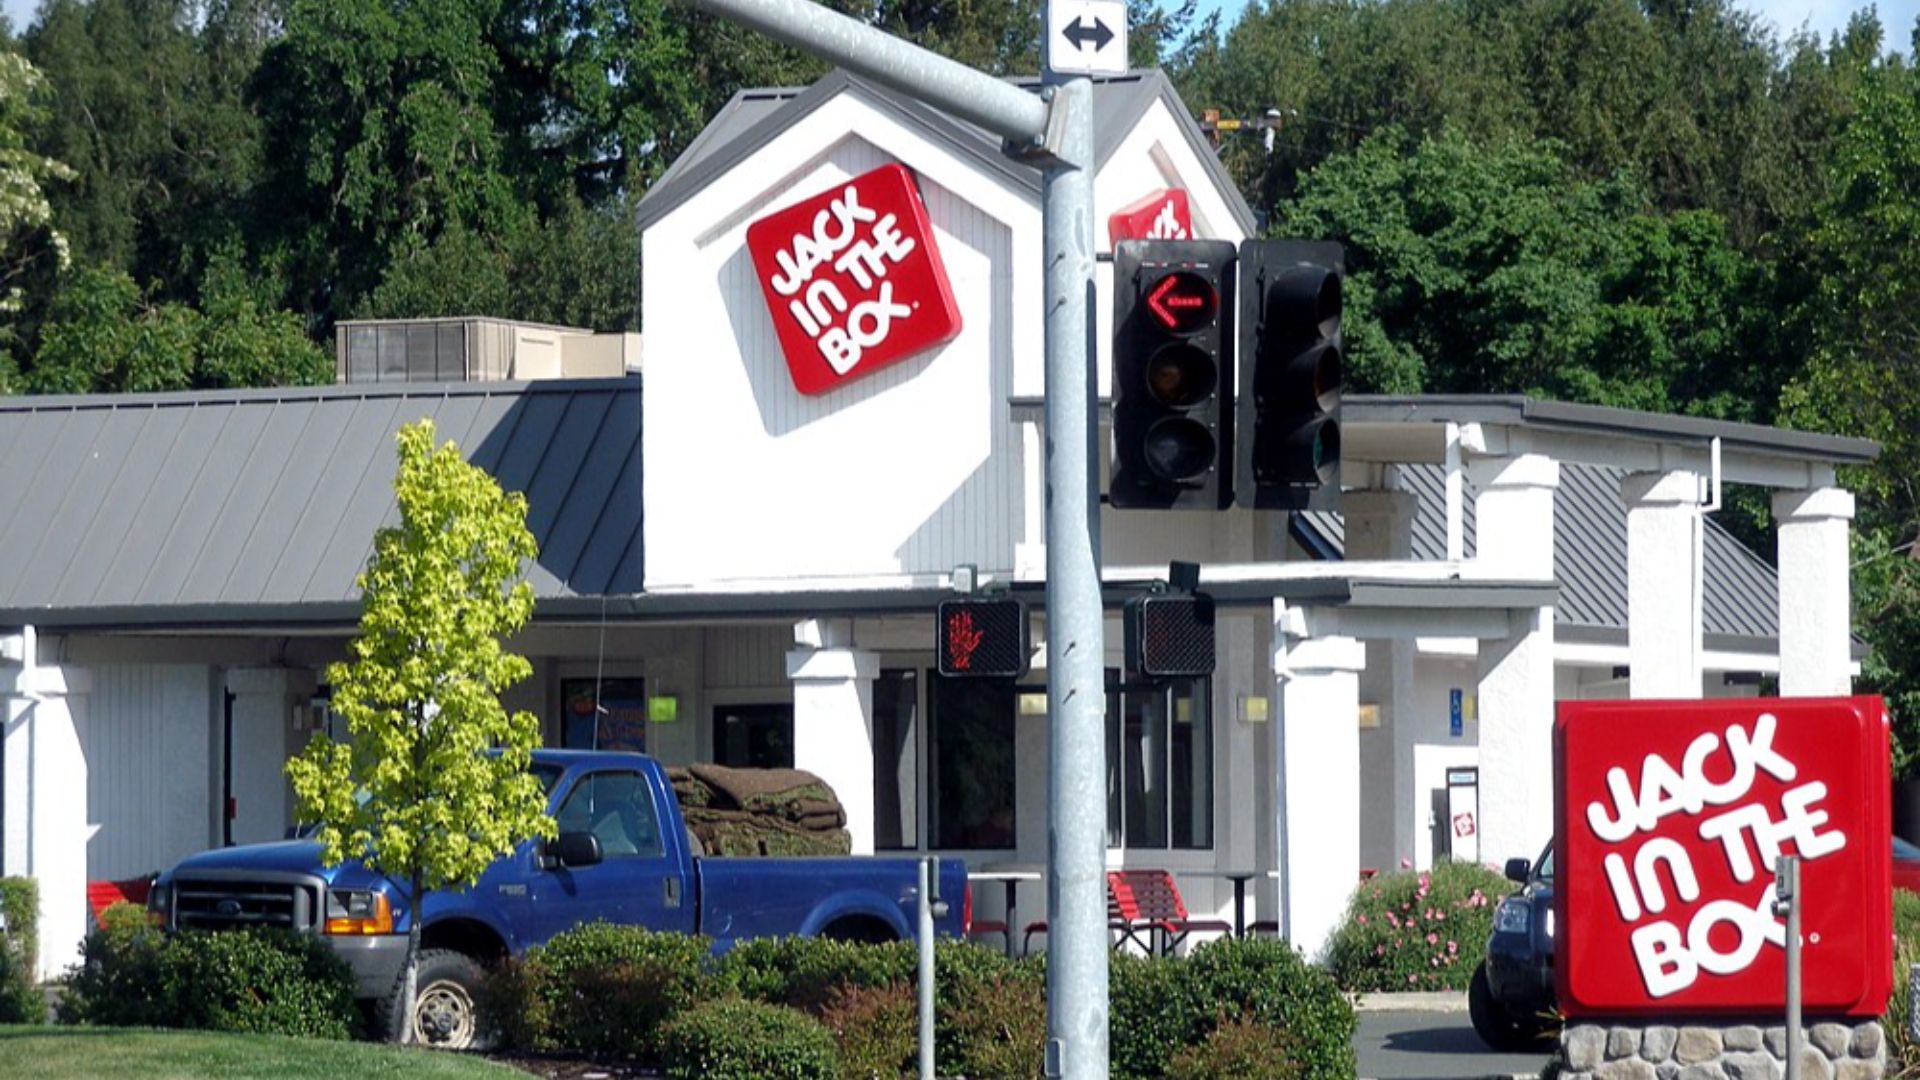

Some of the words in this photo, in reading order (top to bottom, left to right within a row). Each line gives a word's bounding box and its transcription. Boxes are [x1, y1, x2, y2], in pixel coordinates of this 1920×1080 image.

[771, 186, 877, 295] JACK
[790, 279, 848, 337] IN
[835, 213, 915, 289] THE
[817, 281, 912, 375] BOX
[1587, 713, 1797, 842] JACK
[1604, 837, 1700, 921] IN
[1699, 780, 1846, 882] THE
